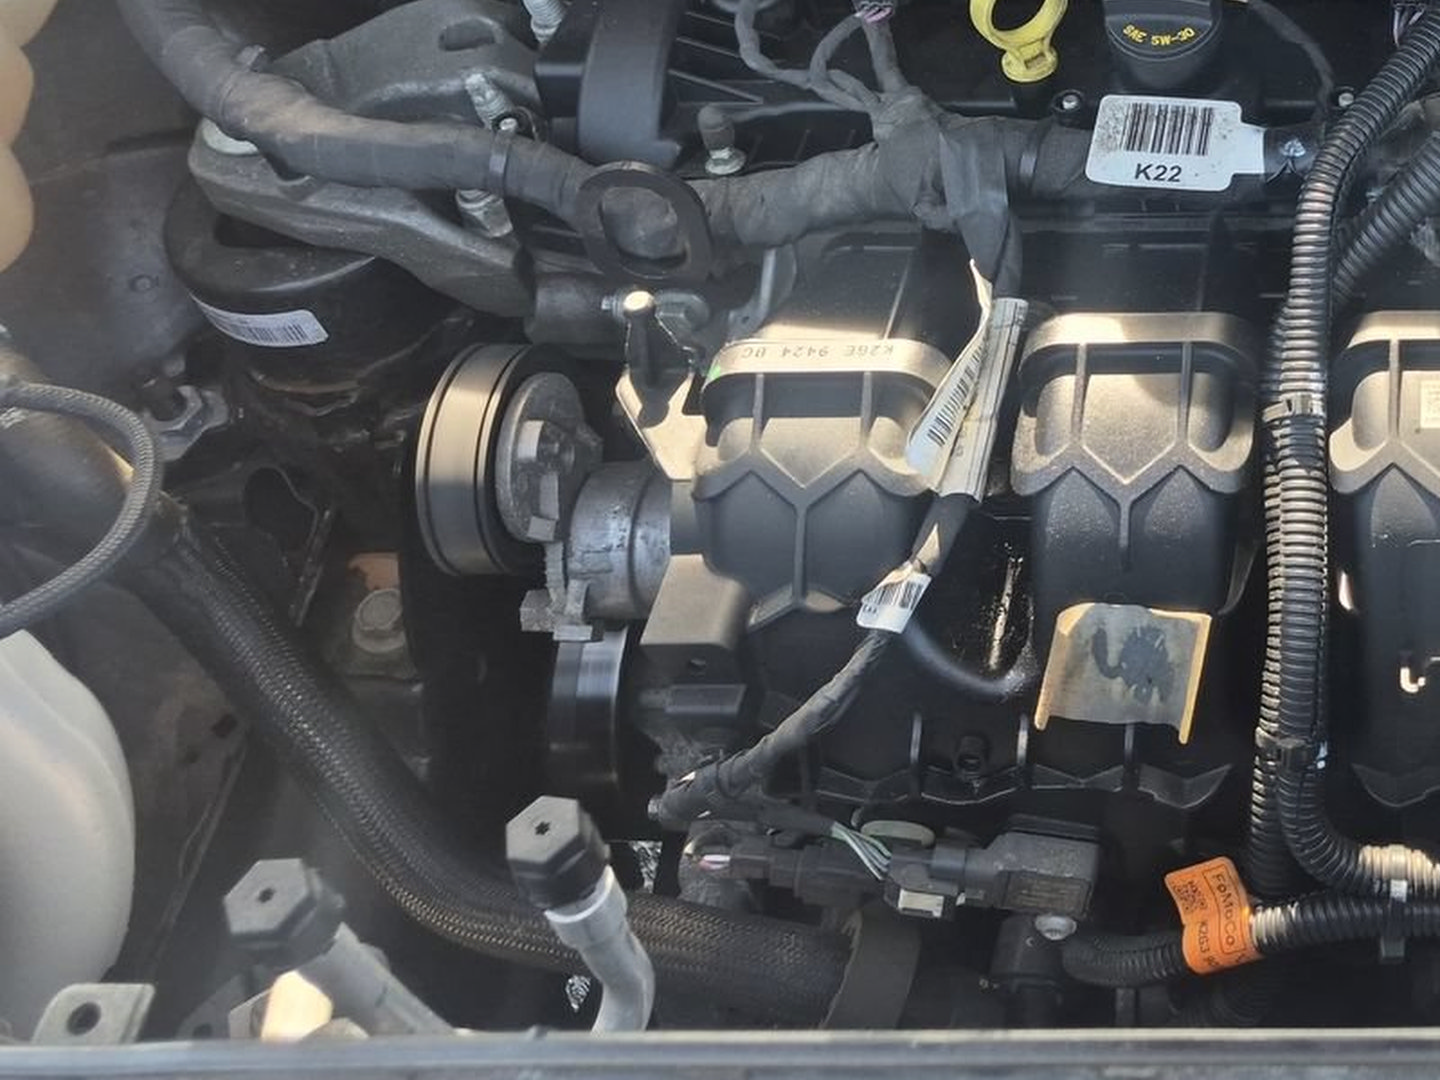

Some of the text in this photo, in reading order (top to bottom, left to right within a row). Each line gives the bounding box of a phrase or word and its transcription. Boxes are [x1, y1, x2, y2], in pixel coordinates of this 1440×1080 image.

[1122, 24, 1196, 46] SAE 5W-30
[1134, 163, 1183, 183] K22
[781, 344, 829, 358] 9424
[1213, 872, 1237, 947] FoMoCo
